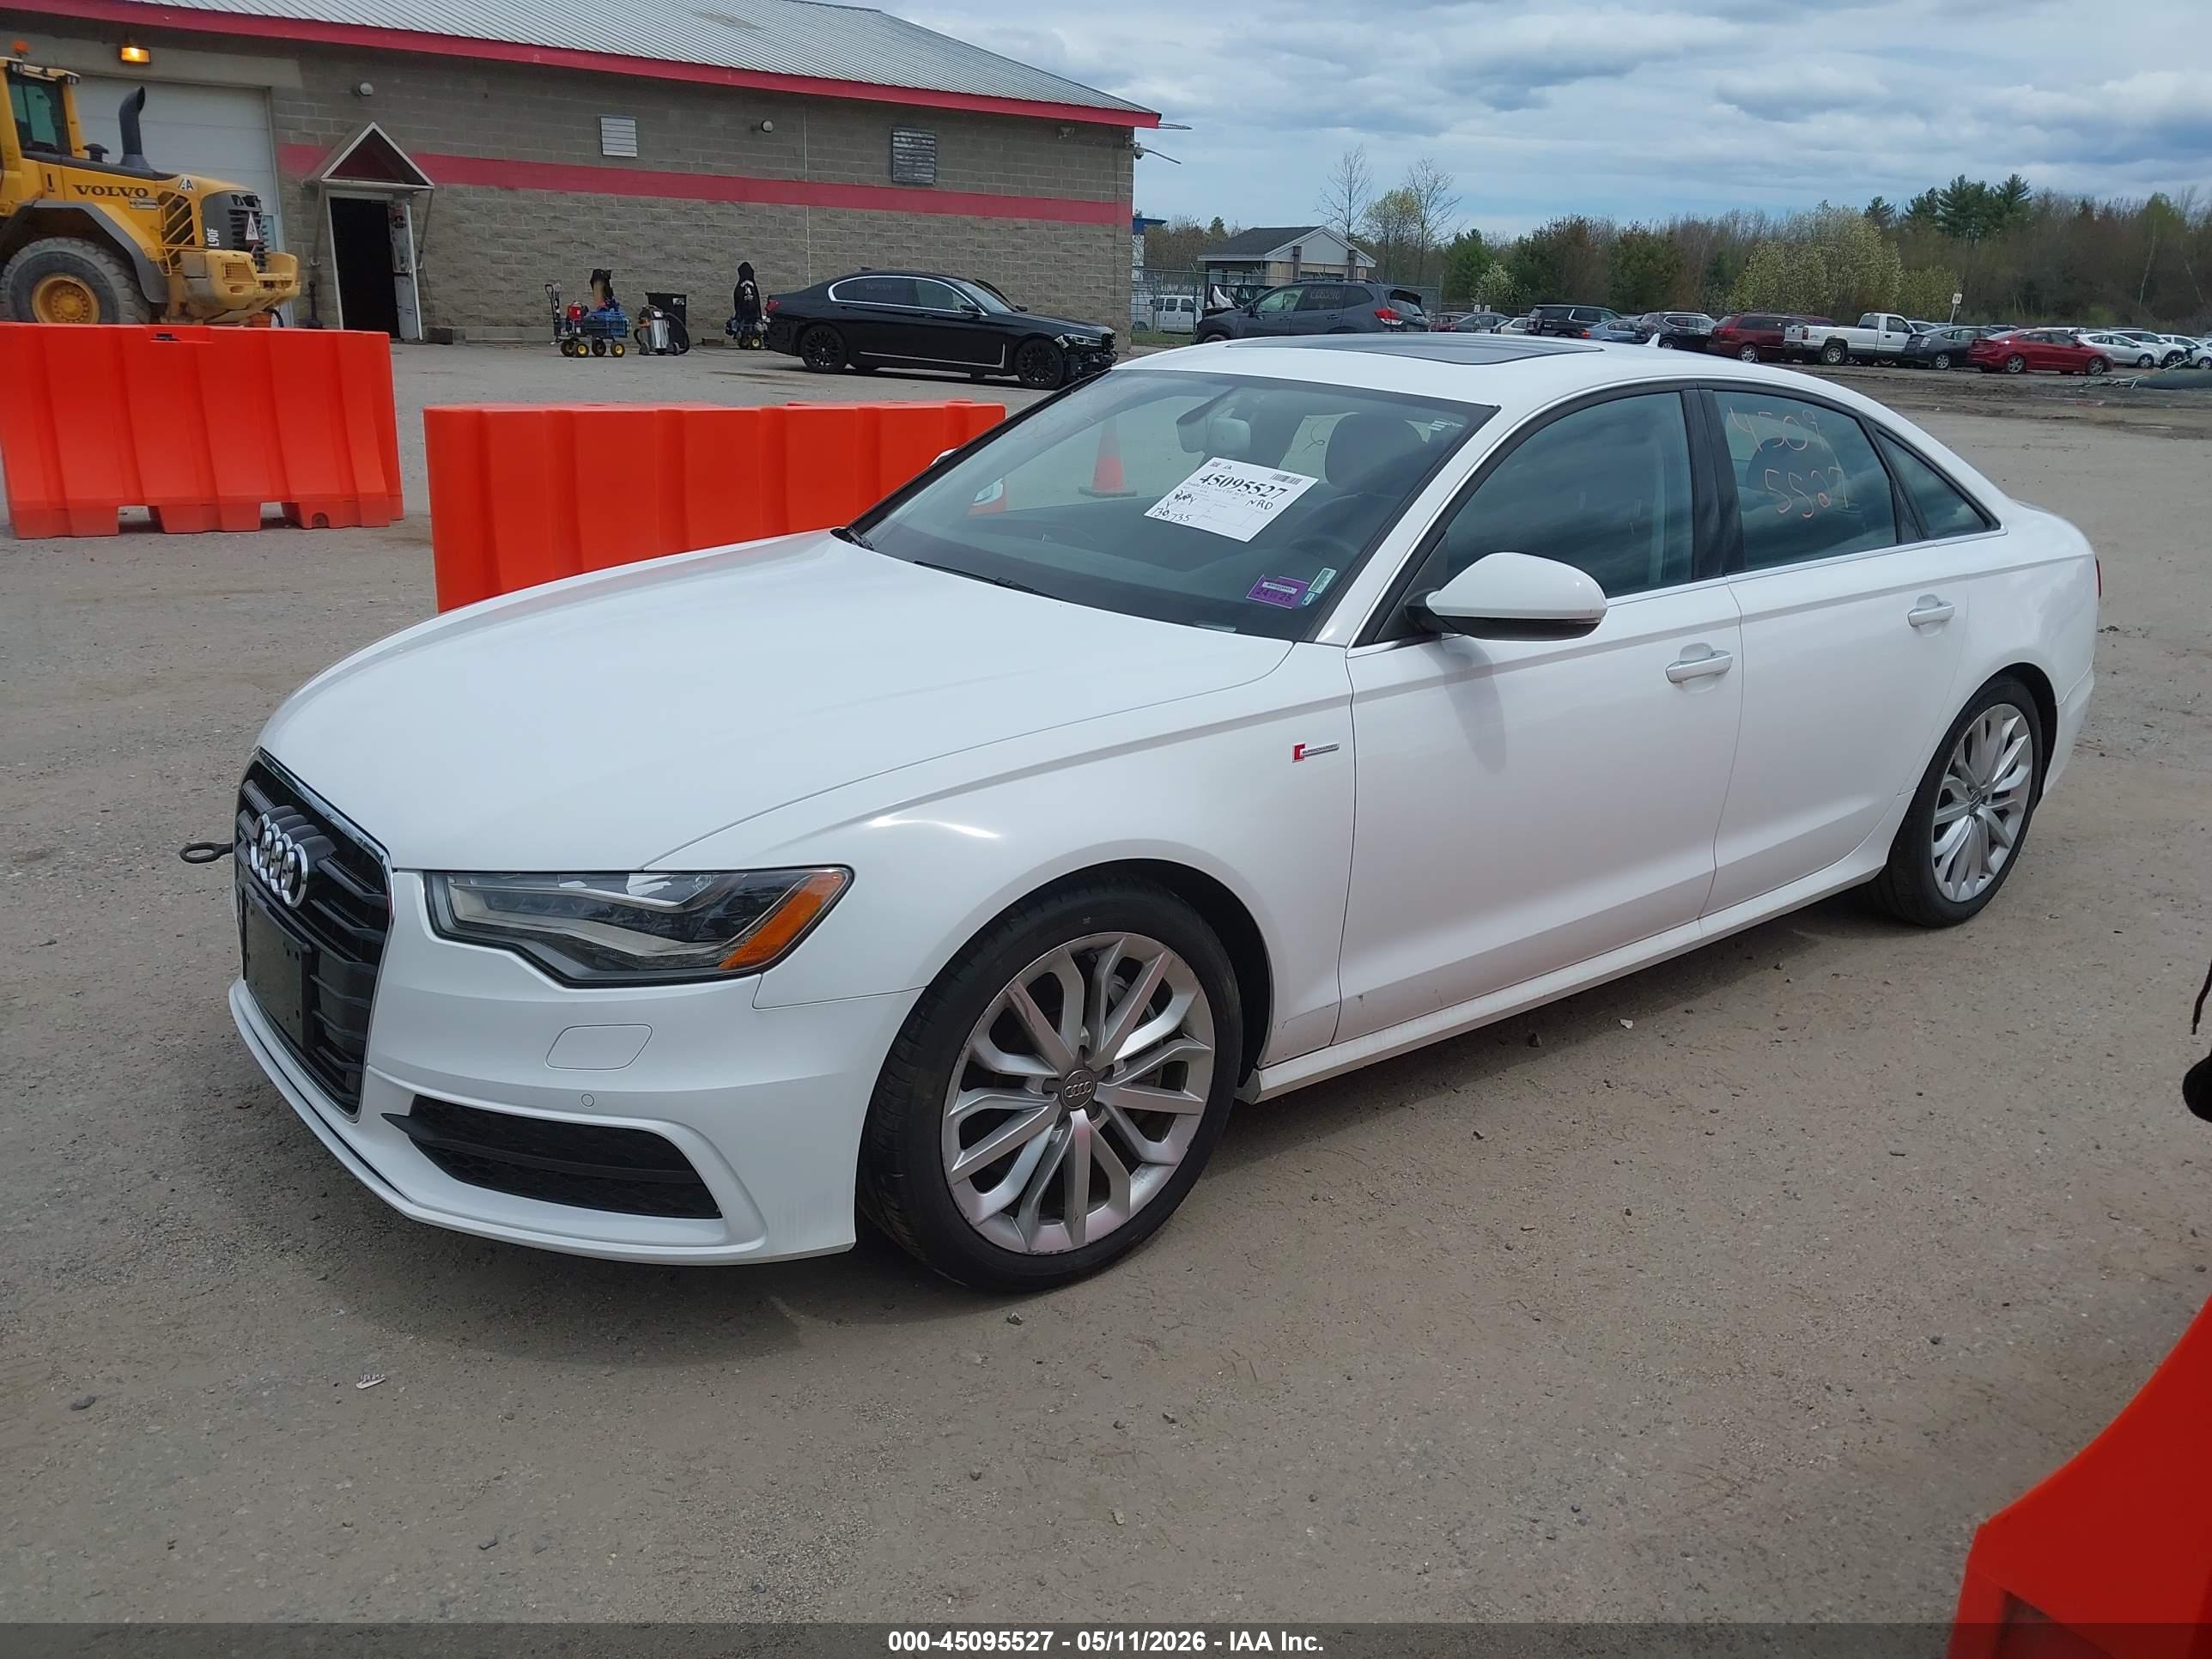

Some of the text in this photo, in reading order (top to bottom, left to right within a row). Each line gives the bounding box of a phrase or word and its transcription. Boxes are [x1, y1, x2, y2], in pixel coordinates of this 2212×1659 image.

[73, 185, 149, 198] VOLVO
[207, 227, 220, 247] L90F
[1729, 407, 1826, 453] 4509
[1200, 472, 1288, 500] 45095527
